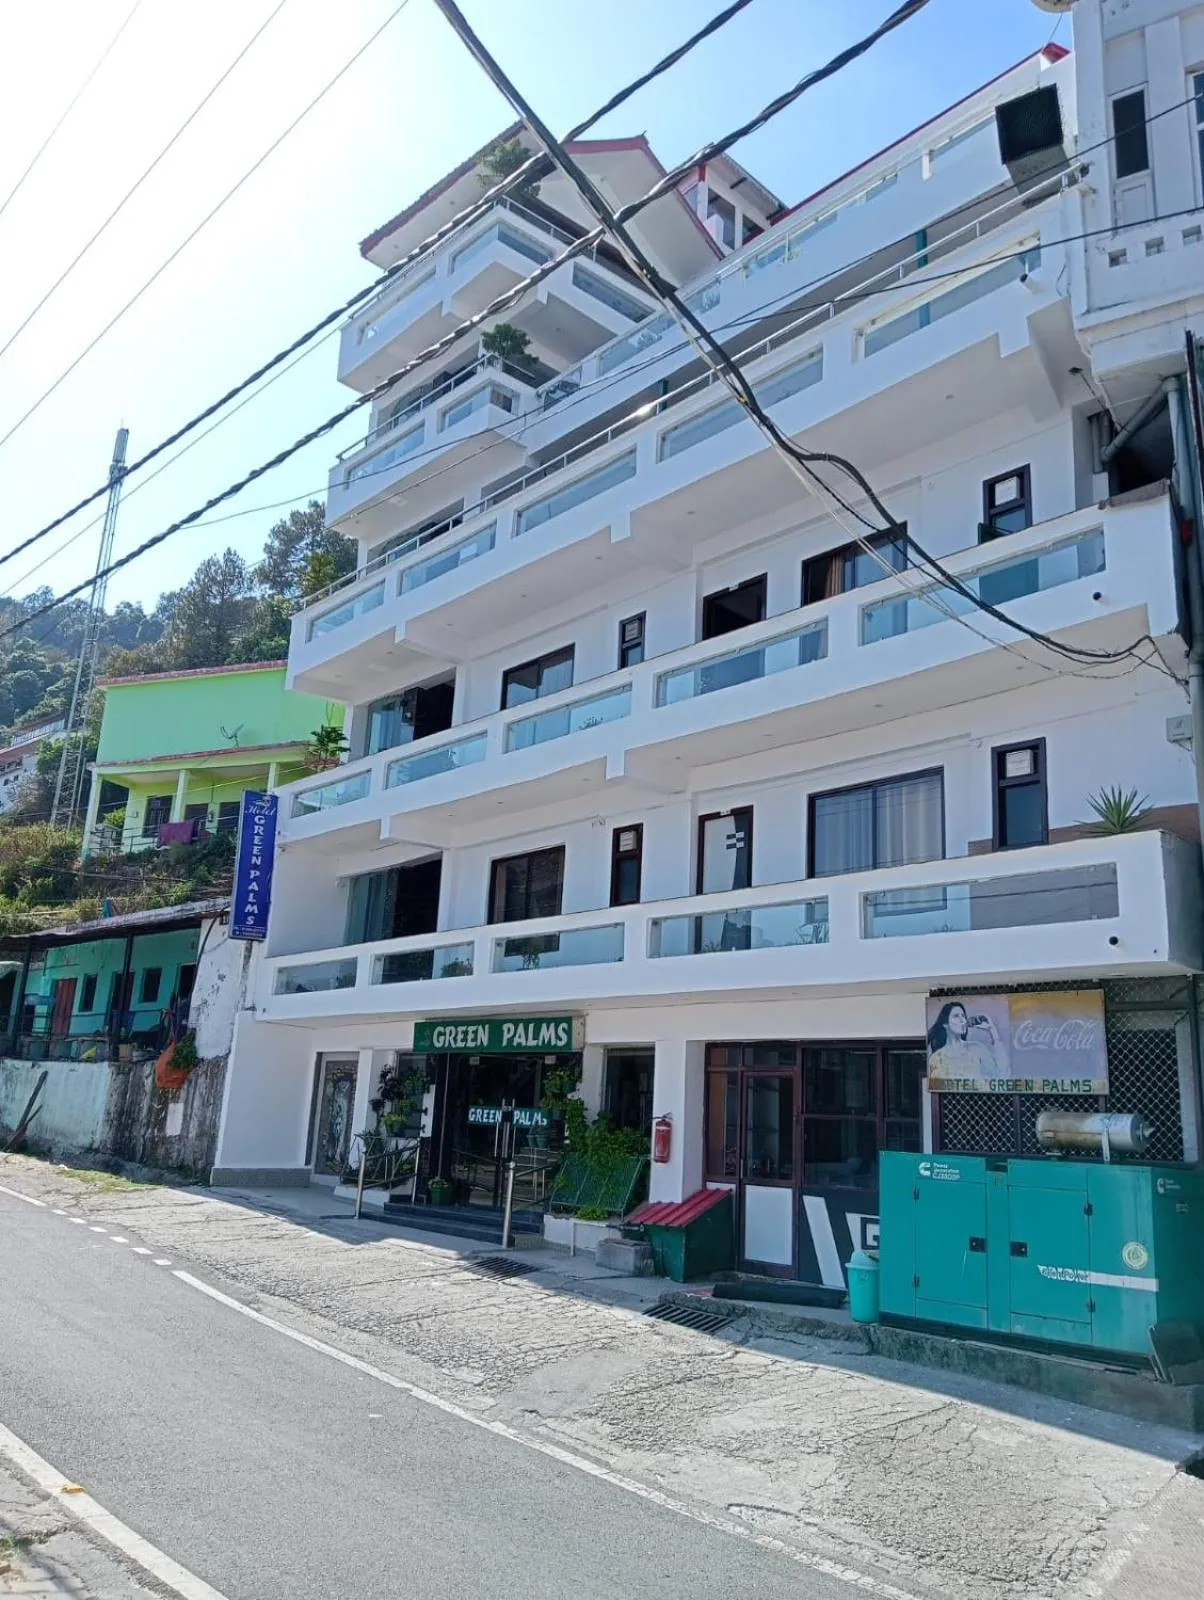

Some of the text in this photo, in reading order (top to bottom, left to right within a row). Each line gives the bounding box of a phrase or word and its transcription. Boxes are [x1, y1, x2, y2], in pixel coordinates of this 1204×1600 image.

[245, 805, 276, 816] Hotel
[251, 815, 266, 866] GREEN
[244, 870, 260, 925] PALMS
[432, 1022, 569, 1048] GREEN PALMS
[989, 1079, 1034, 1092] GREEN
[1042, 1079, 1093, 1092] PALMS
[468, 1108, 502, 1124] GREEN
